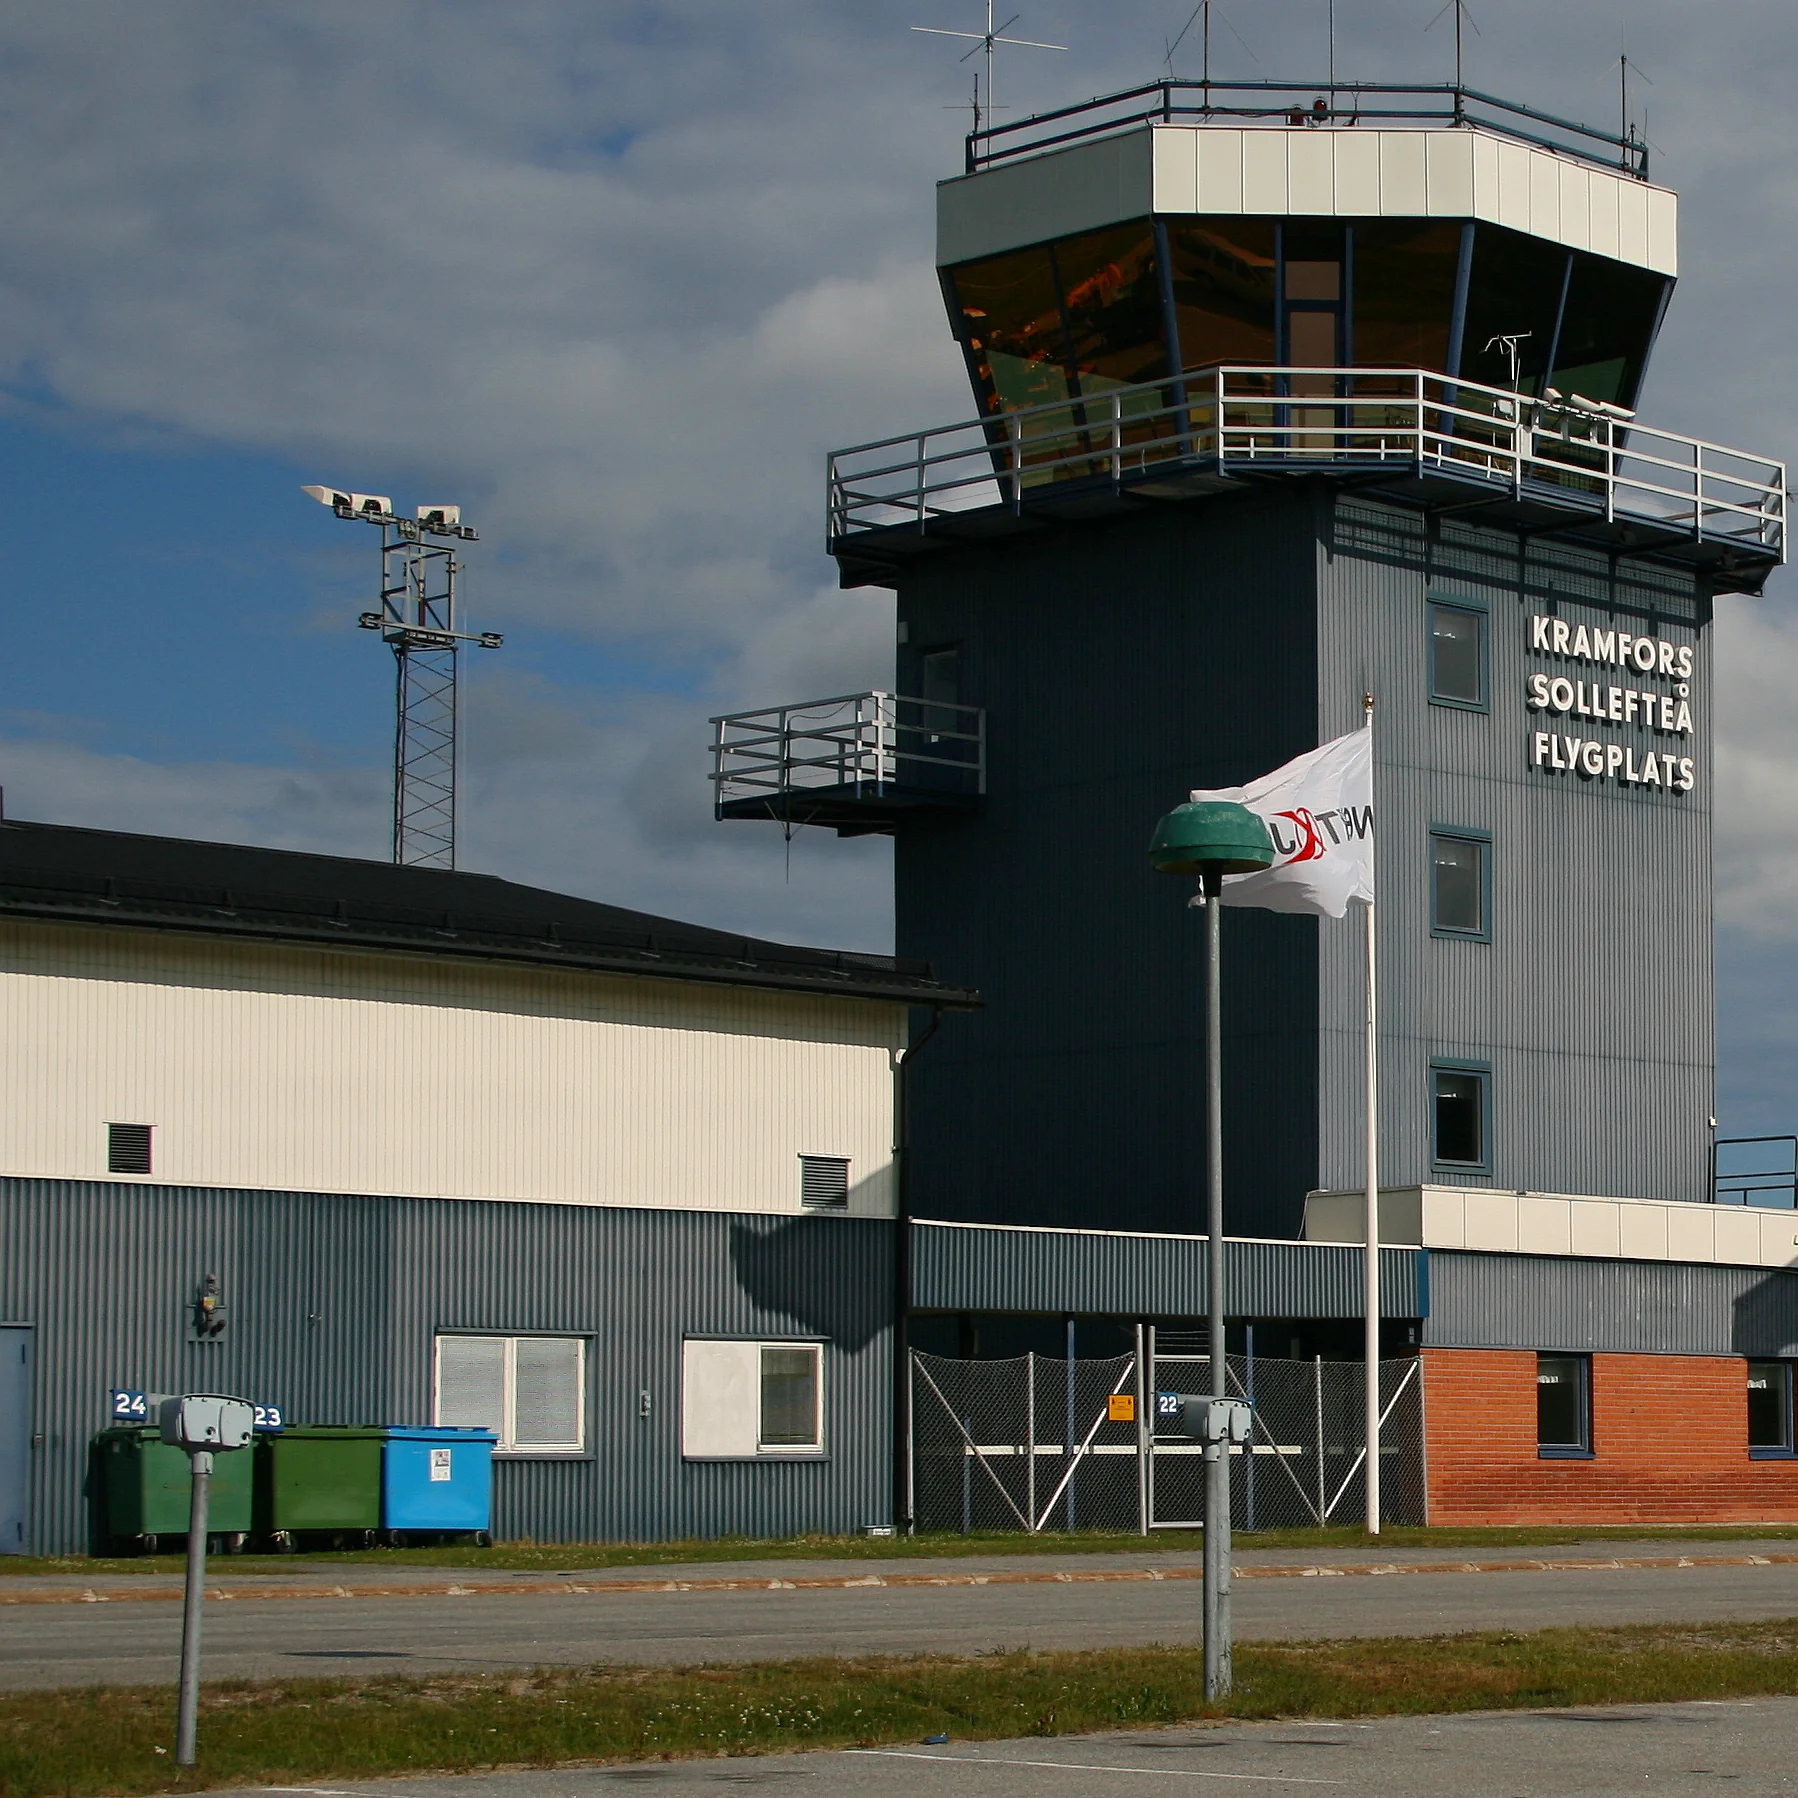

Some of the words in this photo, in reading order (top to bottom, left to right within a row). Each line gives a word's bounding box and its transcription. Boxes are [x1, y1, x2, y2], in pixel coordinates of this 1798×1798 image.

[1530, 615, 1693, 679] KRAMFORS
[1528, 673, 1694, 734] SOLLEFTEÅ
[1531, 731, 1695, 791] FLYGPLATS
[115, 1393, 147, 1415] 24
[253, 1406, 282, 1427] 23
[1159, 1395, 1177, 1413] 22
